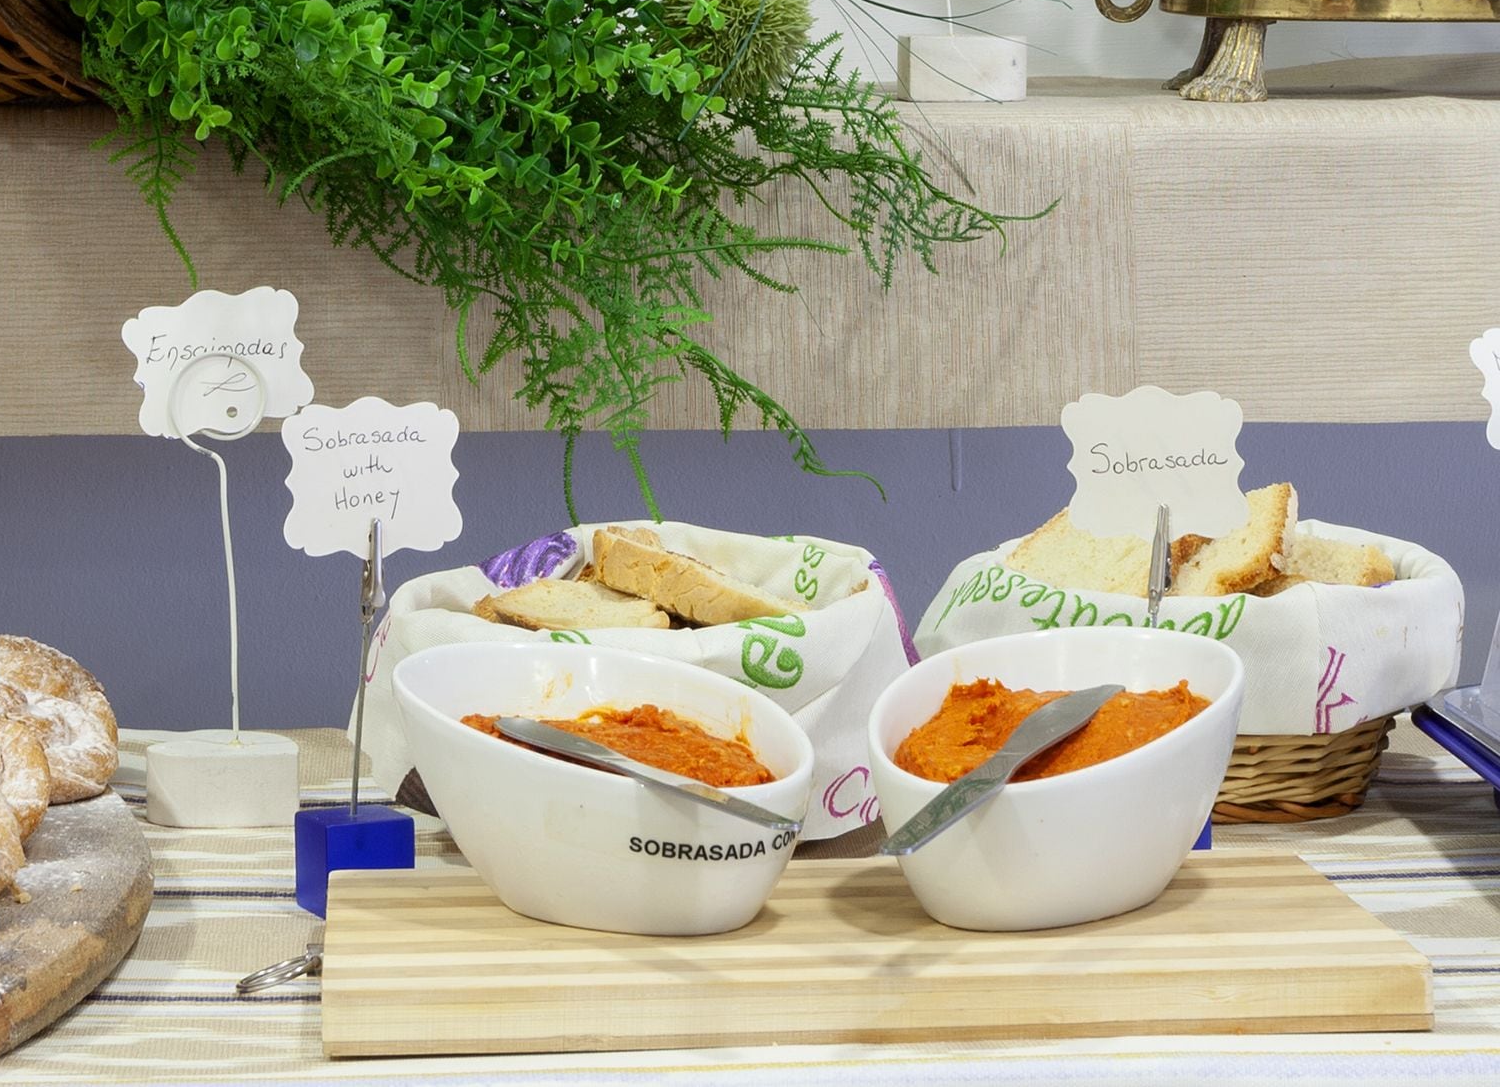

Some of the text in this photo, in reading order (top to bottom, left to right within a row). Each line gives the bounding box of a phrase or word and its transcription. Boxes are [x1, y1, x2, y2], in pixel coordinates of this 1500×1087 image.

[302, 425, 427, 452] Sobrasada
[342, 454, 393, 479] with
[1090, 442, 1228, 474] Sobrasada
[334, 488, 401, 520] Honey
[629, 836, 766, 861] SOBRASADA
